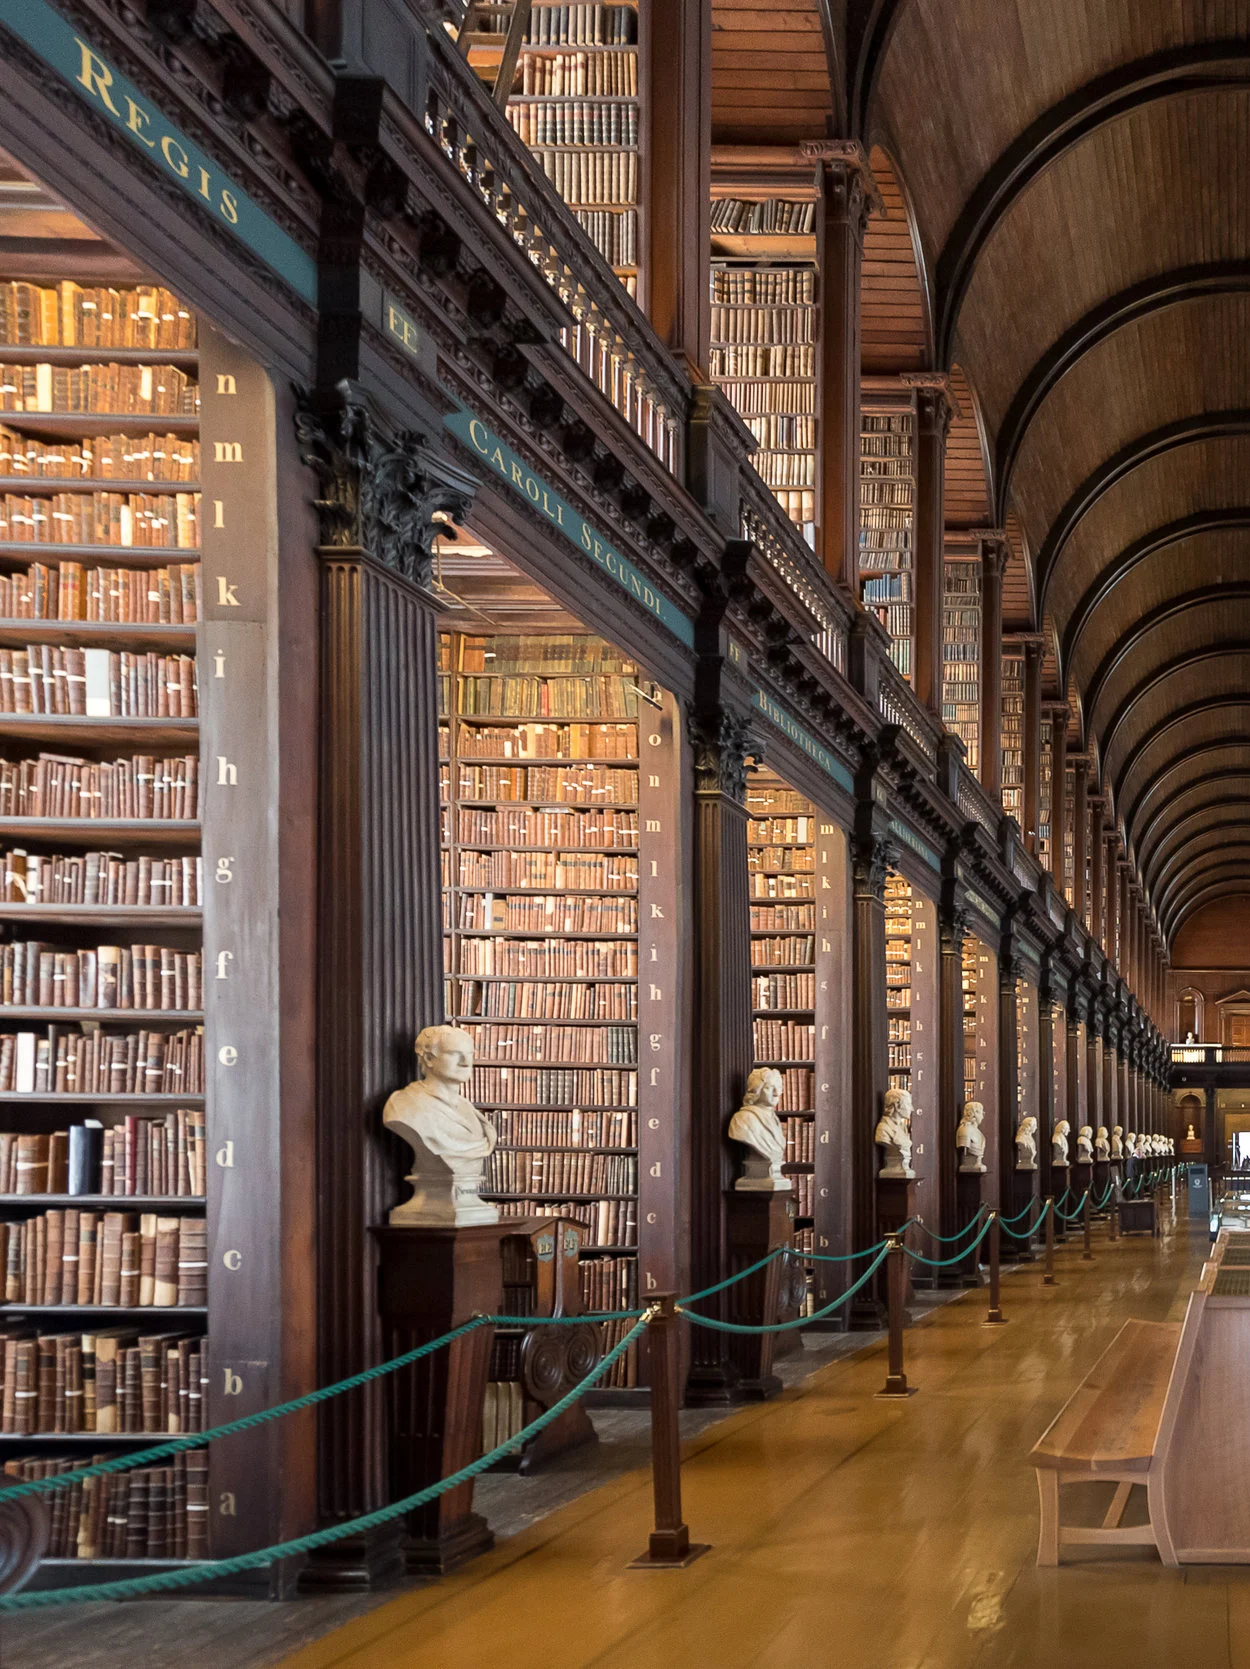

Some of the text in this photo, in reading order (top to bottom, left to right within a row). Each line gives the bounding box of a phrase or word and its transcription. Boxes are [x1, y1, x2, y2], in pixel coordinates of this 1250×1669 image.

[73, 37, 239, 225] REGIS
[387, 305, 419, 355] EE
[216, 374, 237, 394] n
[214, 442, 243, 462] m
[468, 418, 564, 523] CAROLI
[213, 500, 225, 528] l
[216, 576, 241, 606] k
[214, 649, 226, 678] i
[648, 734, 661, 746] o
[758, 689, 832, 771] BIBLIOTHECA
[216, 756, 237, 785] h
[648, 775, 660, 787] n
[646, 820, 661, 832] m
[215, 857, 235, 883] g
[651, 860, 658, 877] l
[650, 904, 664, 918] k
[650, 943, 658, 961] i
[215, 951, 233, 979] f
[649, 984, 661, 1000] h
[650, 1034, 662, 1051] g
[218, 1045, 237, 1066] e
[648, 1118, 659, 1129] e
[216, 1141, 234, 1167] d
[650, 1162, 661, 1177] d
[646, 1213, 656, 1224] c
[223, 1249, 242, 1270] c
[646, 1272, 657, 1289] b
[223, 1368, 243, 1395] b
[219, 1492, 236, 1515] a
